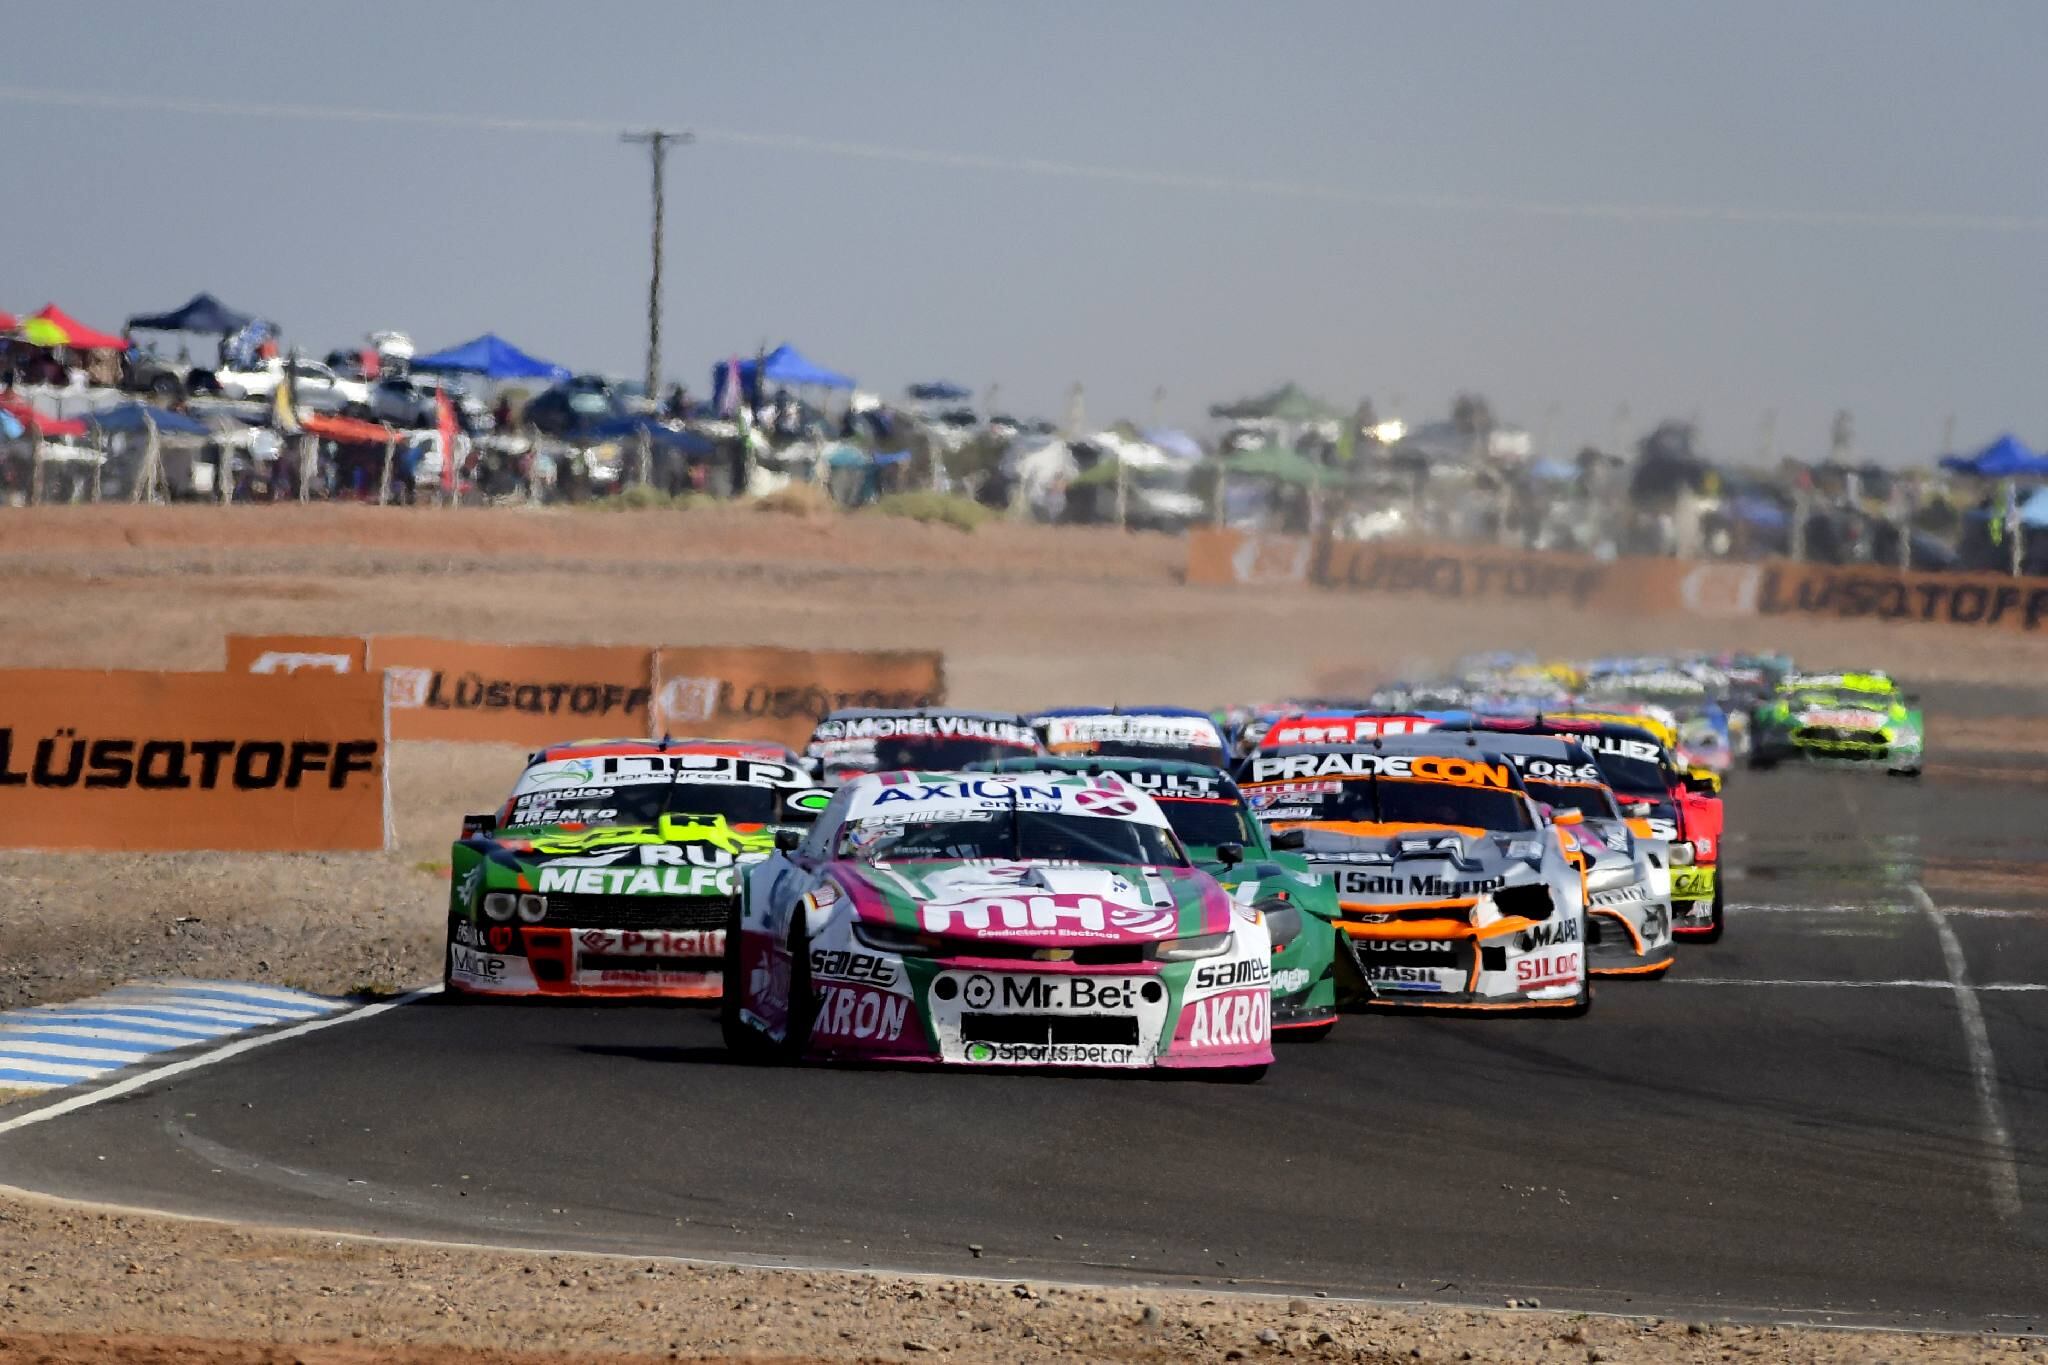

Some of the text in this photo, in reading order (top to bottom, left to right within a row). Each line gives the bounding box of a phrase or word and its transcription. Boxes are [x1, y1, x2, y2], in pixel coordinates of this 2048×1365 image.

[1253, 752, 1509, 788] PRADECON
[872, 778, 1063, 807] AXION
[979, 798, 1063, 812] energy
[514, 808, 619, 823] TRENTO
[1346, 871, 1404, 895] San
[1196, 957, 1270, 988] samet
[1069, 976, 1137, 1009] Bet
